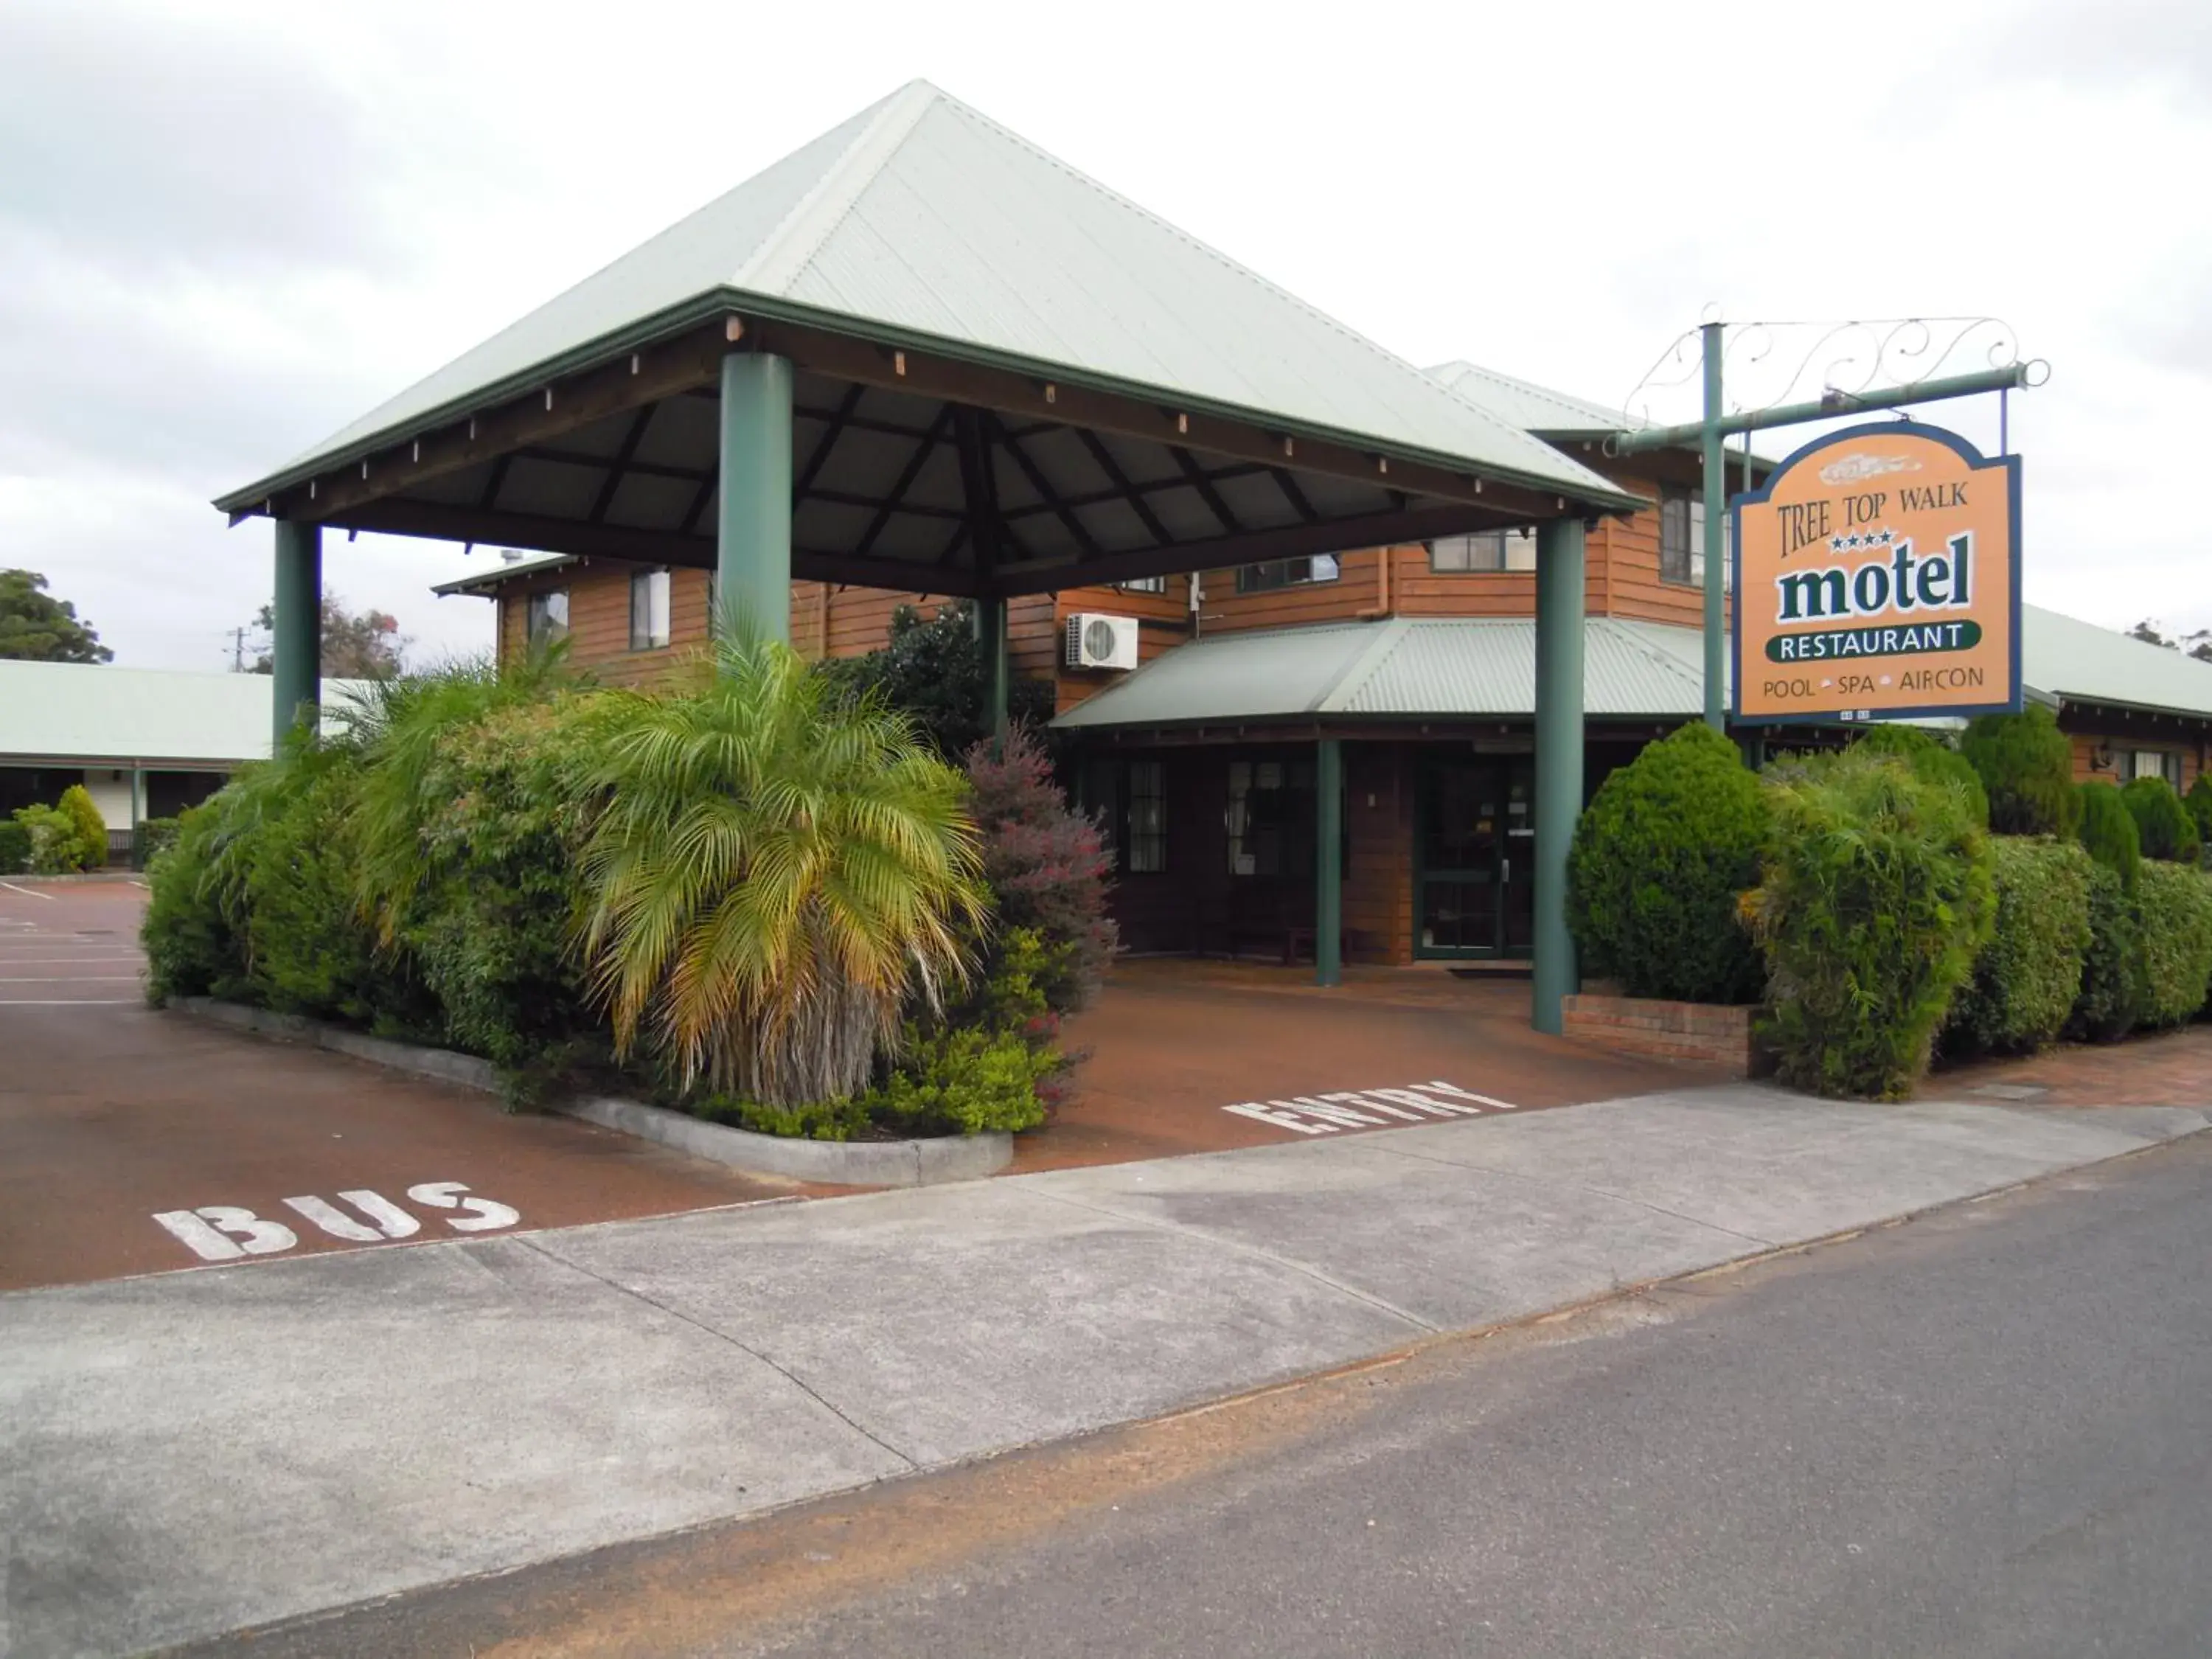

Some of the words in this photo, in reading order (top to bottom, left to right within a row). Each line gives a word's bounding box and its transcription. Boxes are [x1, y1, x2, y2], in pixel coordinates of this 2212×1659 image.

[1778, 500, 1830, 559] TREE
[1843, 492, 1887, 527] TOP
[1900, 481, 1968, 513] WALK
[1778, 532, 1971, 622] motel
[1781, 625, 1963, 659] RESTAURANT
[1764, 678, 1816, 698] POOL
[1837, 675, 1875, 695] SPA
[1899, 667, 1983, 692] AIRCON
[1221, 1080, 1517, 1134] ENTRY
[150, 1181, 521, 1261] BUS
